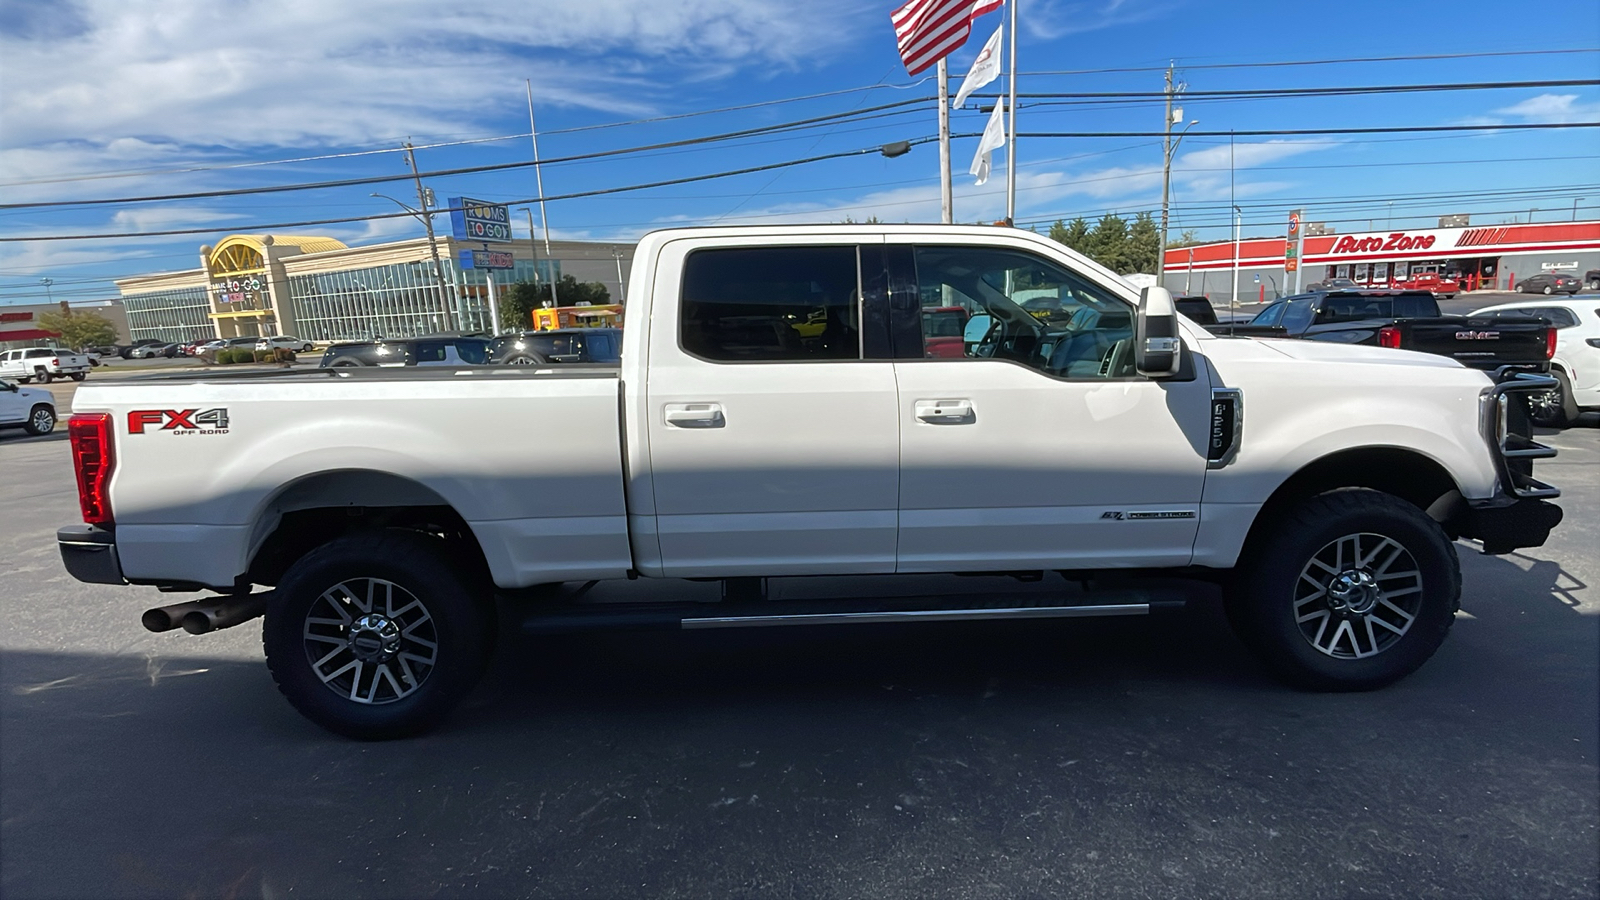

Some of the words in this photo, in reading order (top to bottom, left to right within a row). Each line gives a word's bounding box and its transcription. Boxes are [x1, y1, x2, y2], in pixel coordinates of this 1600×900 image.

[467, 203, 505, 221] ROOMS
[470, 222, 484, 236] TO
[486, 224, 502, 238] GO
[1455, 330, 1500, 340] GMC
[127, 407, 230, 435] FX4
